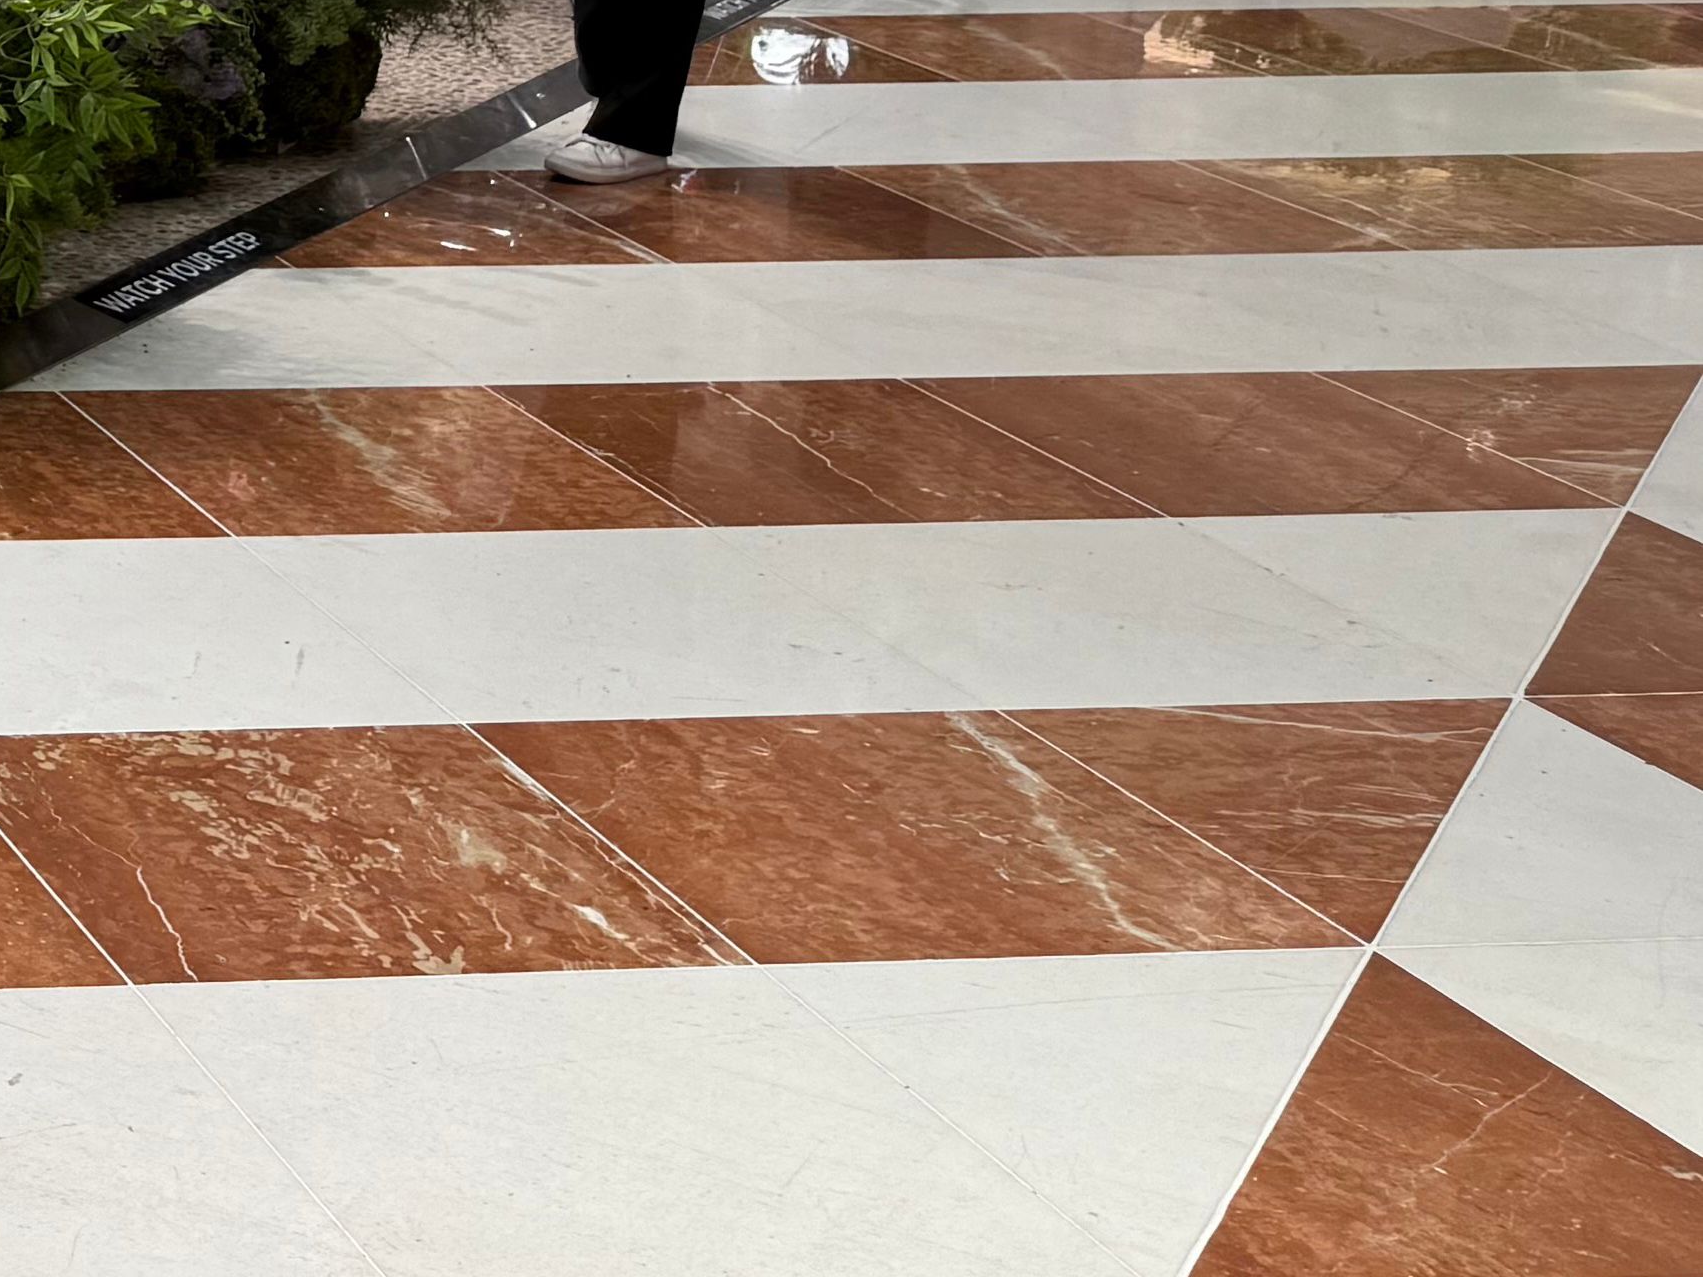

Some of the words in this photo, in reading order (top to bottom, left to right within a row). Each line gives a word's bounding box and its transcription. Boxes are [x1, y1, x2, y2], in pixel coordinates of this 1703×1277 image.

[93, 273, 176, 313] WATCH
[163, 251, 222, 283] YOUR
[212, 231, 261, 260] STEP
